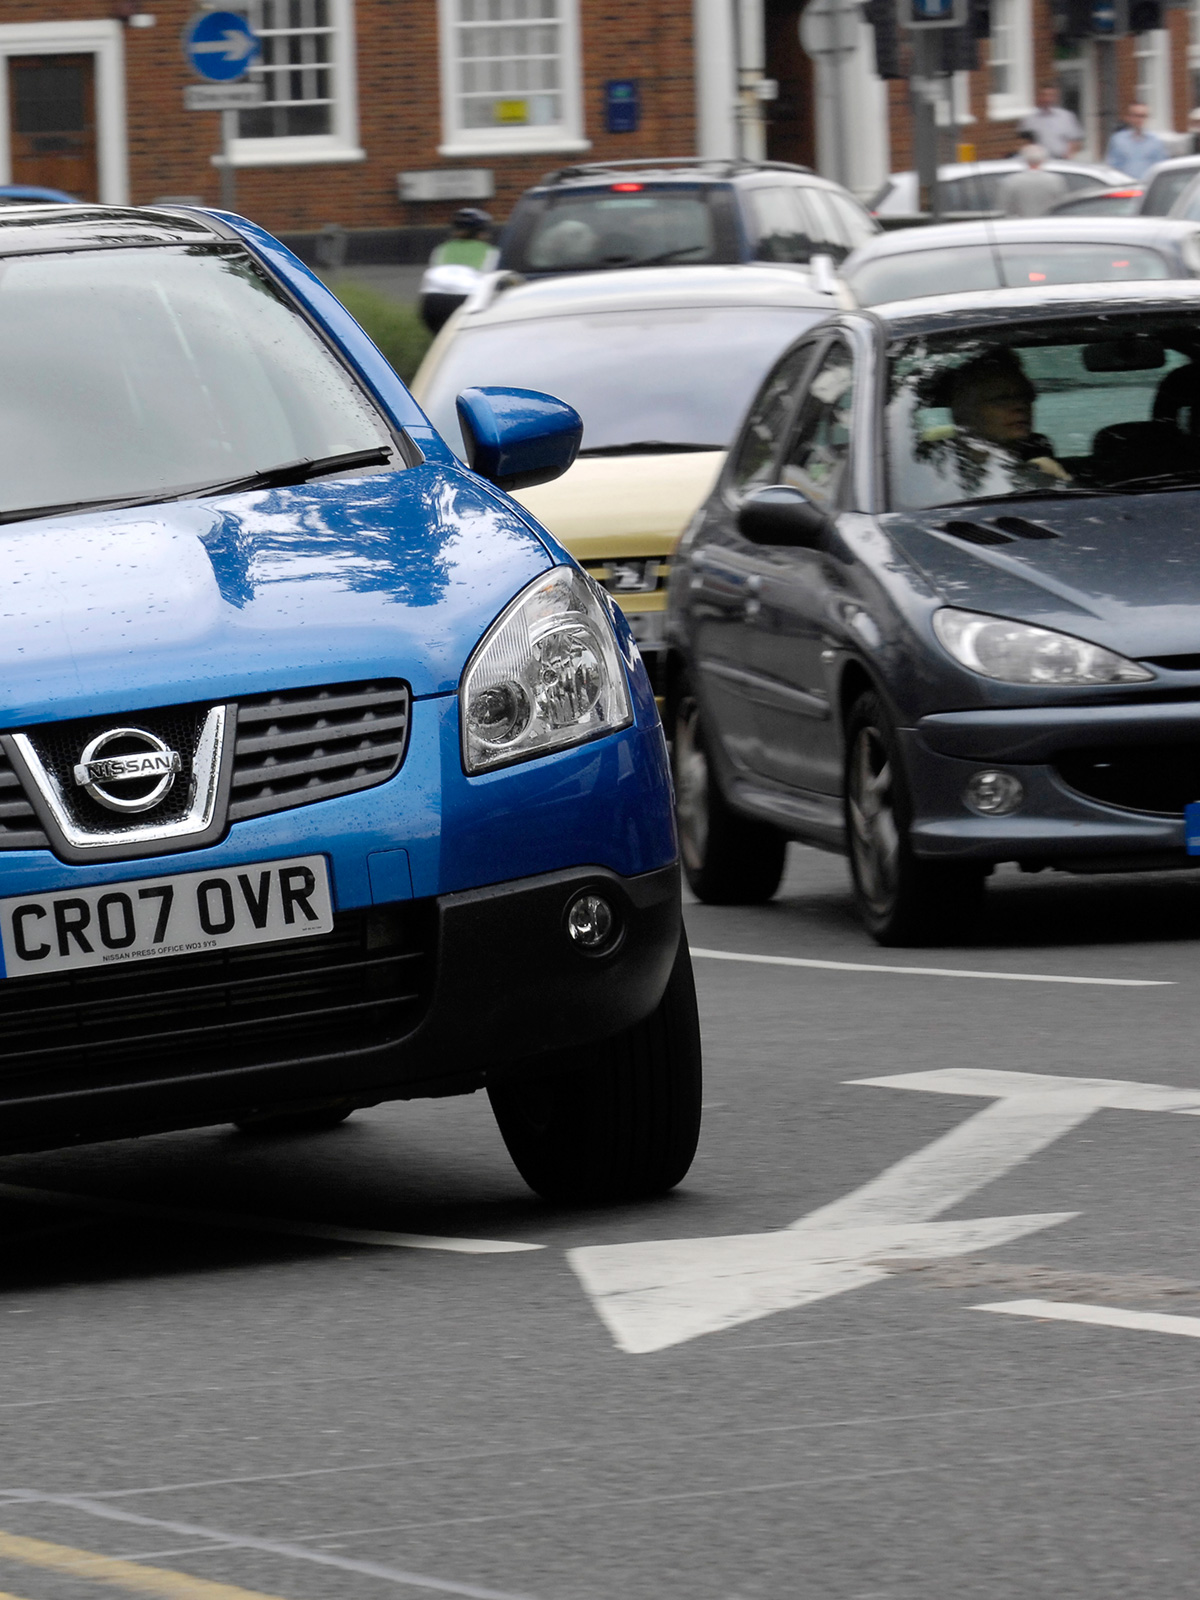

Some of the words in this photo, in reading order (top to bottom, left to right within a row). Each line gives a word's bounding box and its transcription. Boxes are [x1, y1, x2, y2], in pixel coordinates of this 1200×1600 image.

[87, 756, 170, 779] NISSAN
[11, 884, 175, 962] CR07
[196, 865, 320, 936] OVR
[102, 952, 130, 962] NISSAN
[132, 949, 156, 958] PRESS
[158, 944, 184, 954] OFFICE
